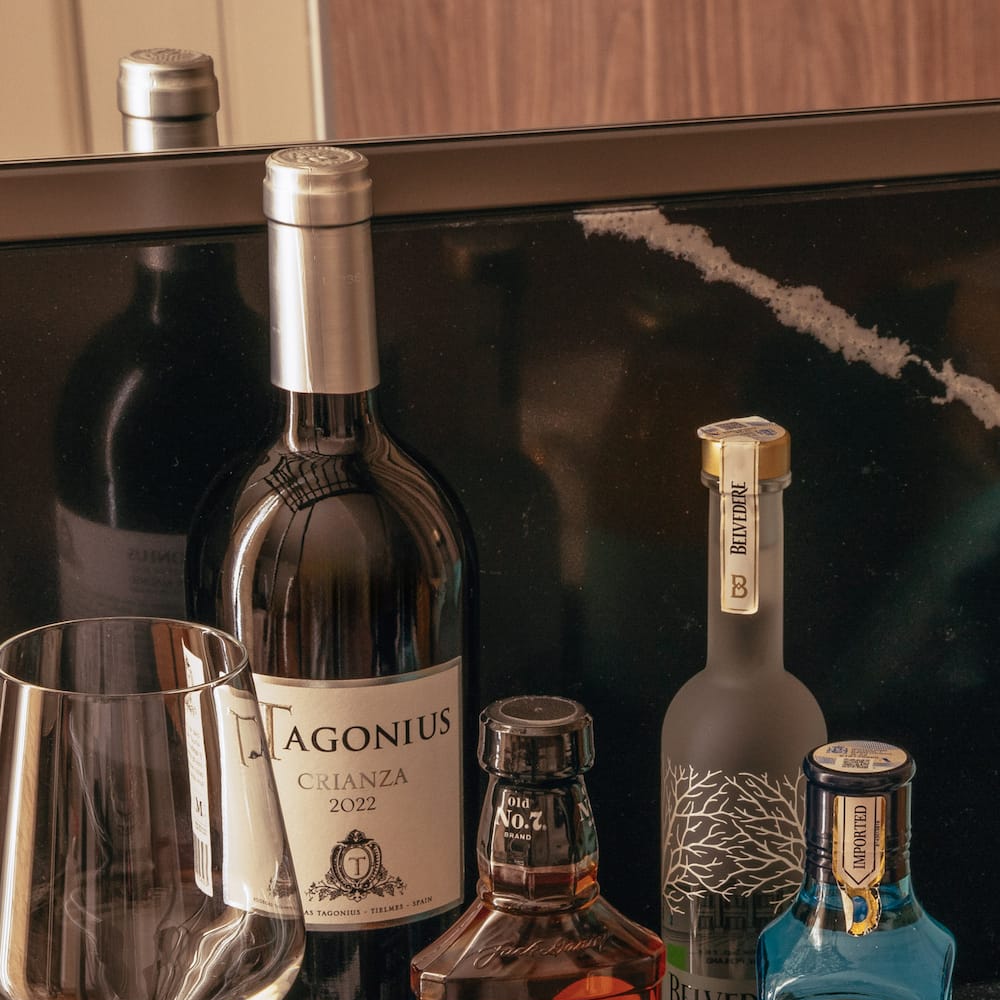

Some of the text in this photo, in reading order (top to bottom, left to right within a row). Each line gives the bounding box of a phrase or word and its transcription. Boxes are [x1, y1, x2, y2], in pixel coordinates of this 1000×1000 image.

[730, 481, 748, 556] BELVEDERE
[258, 701, 451, 761] TAGONIUS
[297, 767, 409, 792] CRIANZA
[328, 795, 377, 813] 2022
[503, 832, 532, 841] BRAND
[853, 805, 867, 870] IMPORTED
[317, 909, 361, 917] TAGONIUS
[412, 895, 433, 907] SPAIN
